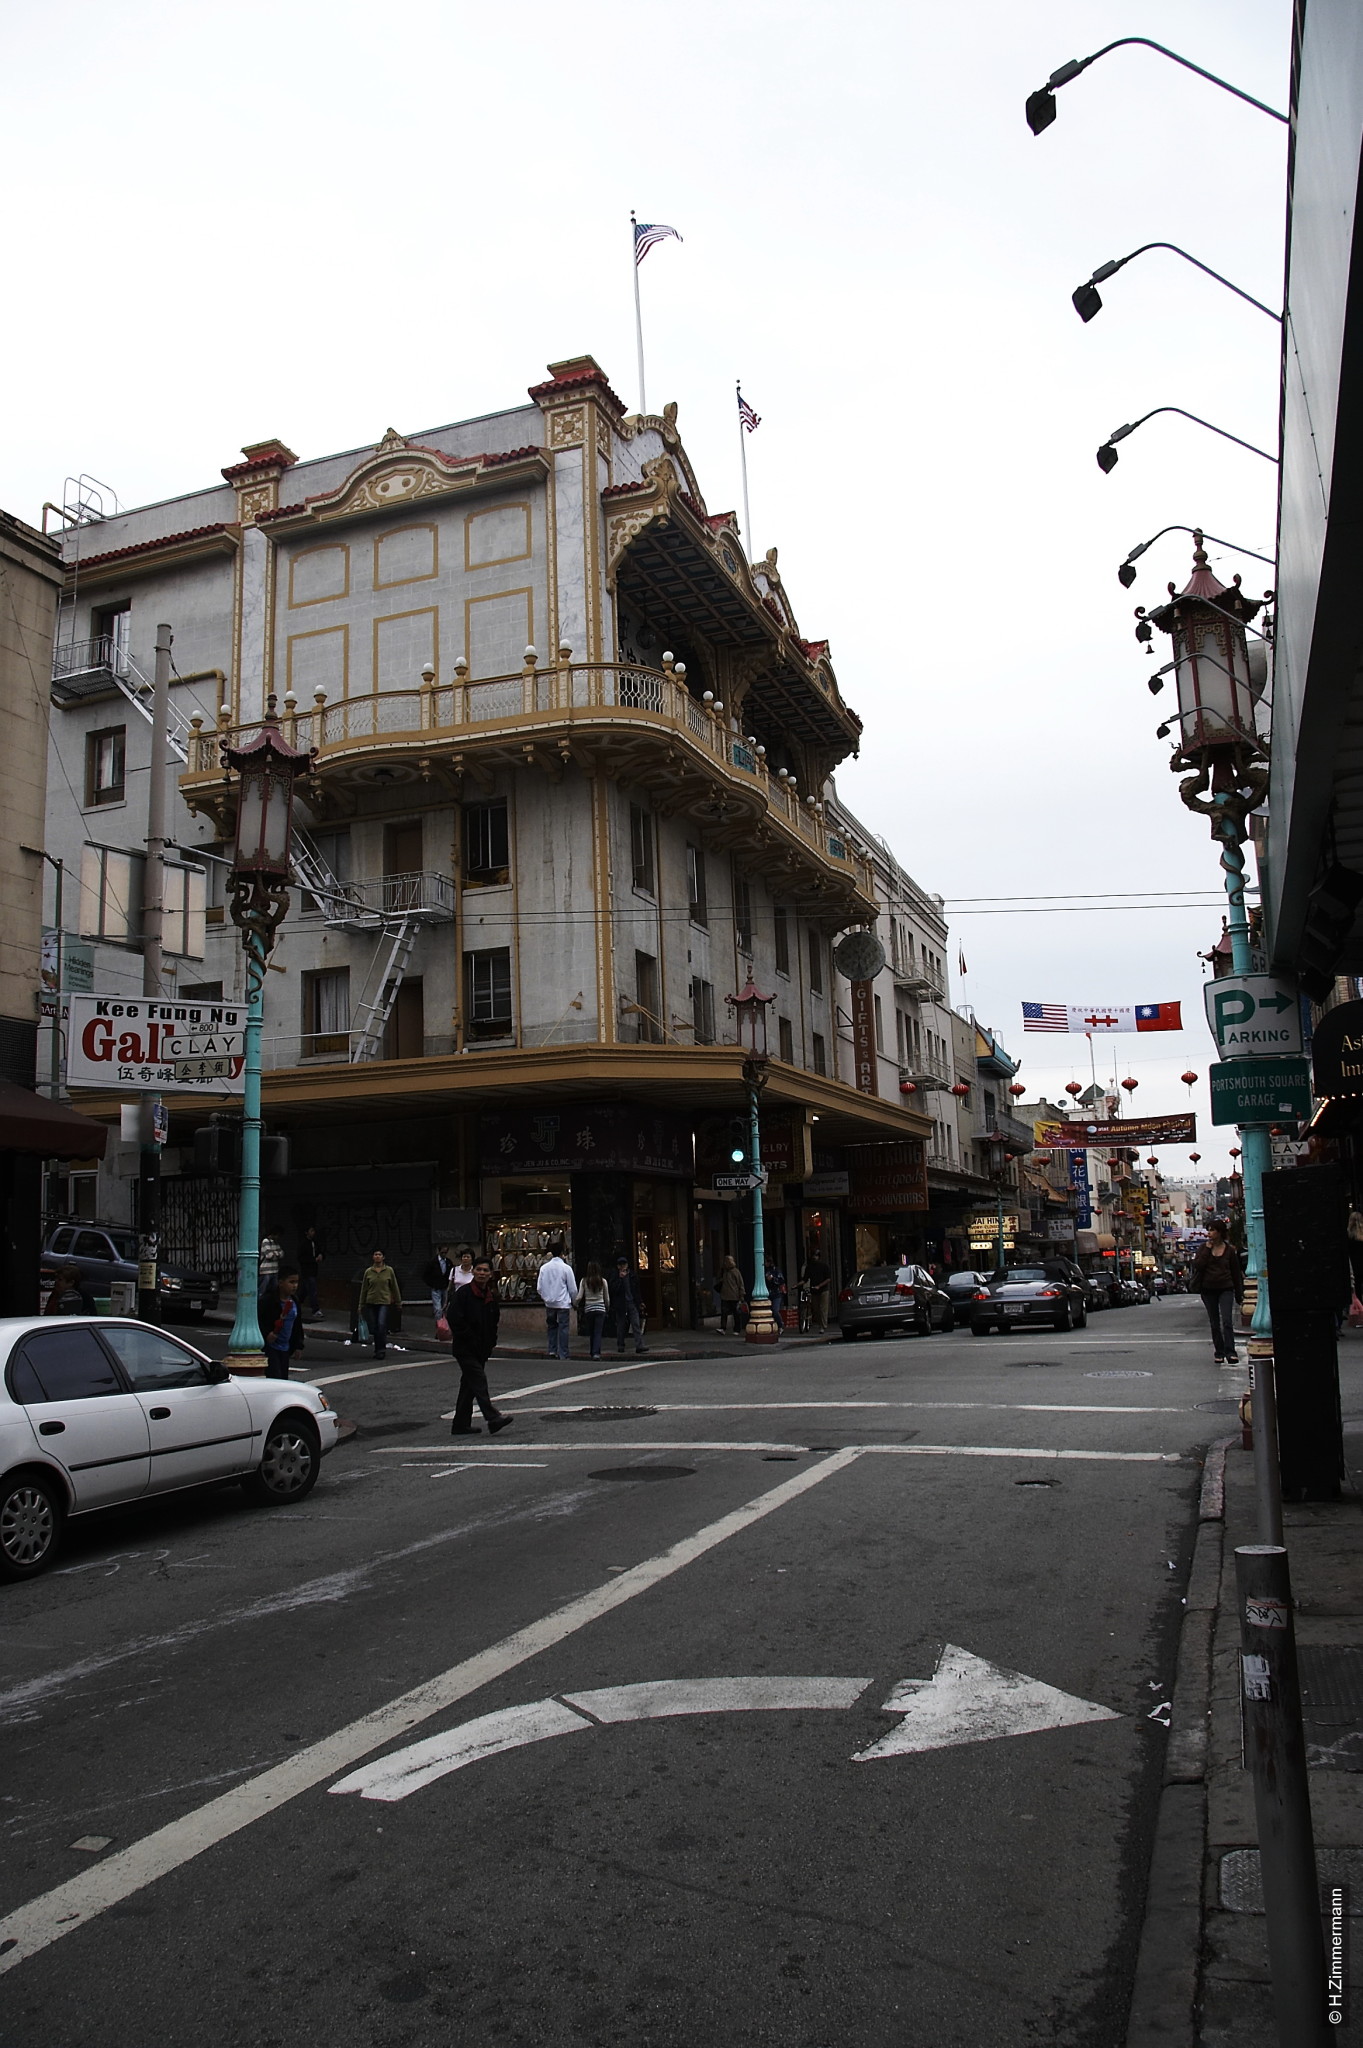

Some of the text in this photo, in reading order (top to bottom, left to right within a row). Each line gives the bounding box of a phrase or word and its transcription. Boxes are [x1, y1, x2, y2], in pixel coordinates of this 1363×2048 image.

[96, 1001, 238, 1026] Kee Fung Ng
[856, 988, 868, 1047] GIFTS
[171, 1036, 236, 1055] CLAY
[117, 1065, 213, 1084] 伍奇峰
[1340, 1060, 1363, 1077] Im
[1211, 1074, 1307, 1092] PORTSMOUTH SQUARE
[1237, 1093, 1276, 1107] GARAGE
[1110, 1124, 1139, 1132] Autumn
[762, 1143, 790, 1153] ELRY
[1272, 1143, 1303, 1154] LAY
[764, 1160, 788, 1170] RTS
[718, 1177, 749, 1186] ONE WAY
